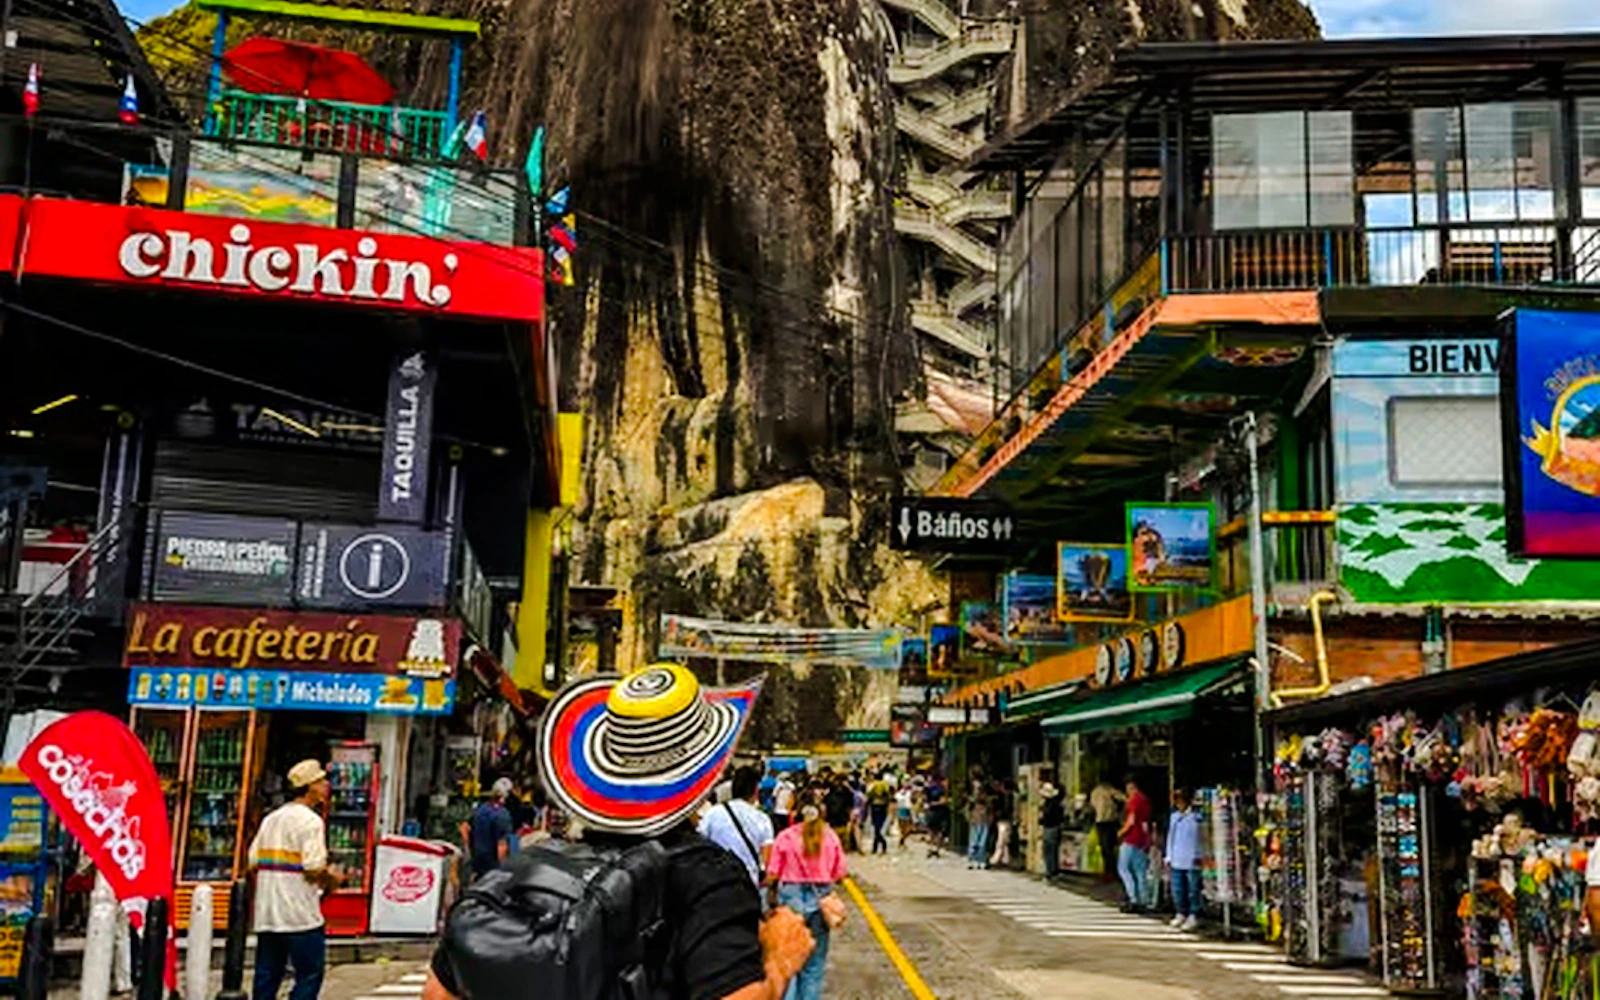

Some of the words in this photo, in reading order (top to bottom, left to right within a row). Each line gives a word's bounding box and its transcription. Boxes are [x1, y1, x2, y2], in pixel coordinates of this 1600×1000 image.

[391, 385, 420, 504] TAQUILLA
[128, 612, 183, 654] La
[192, 616, 380, 668] cafetería
